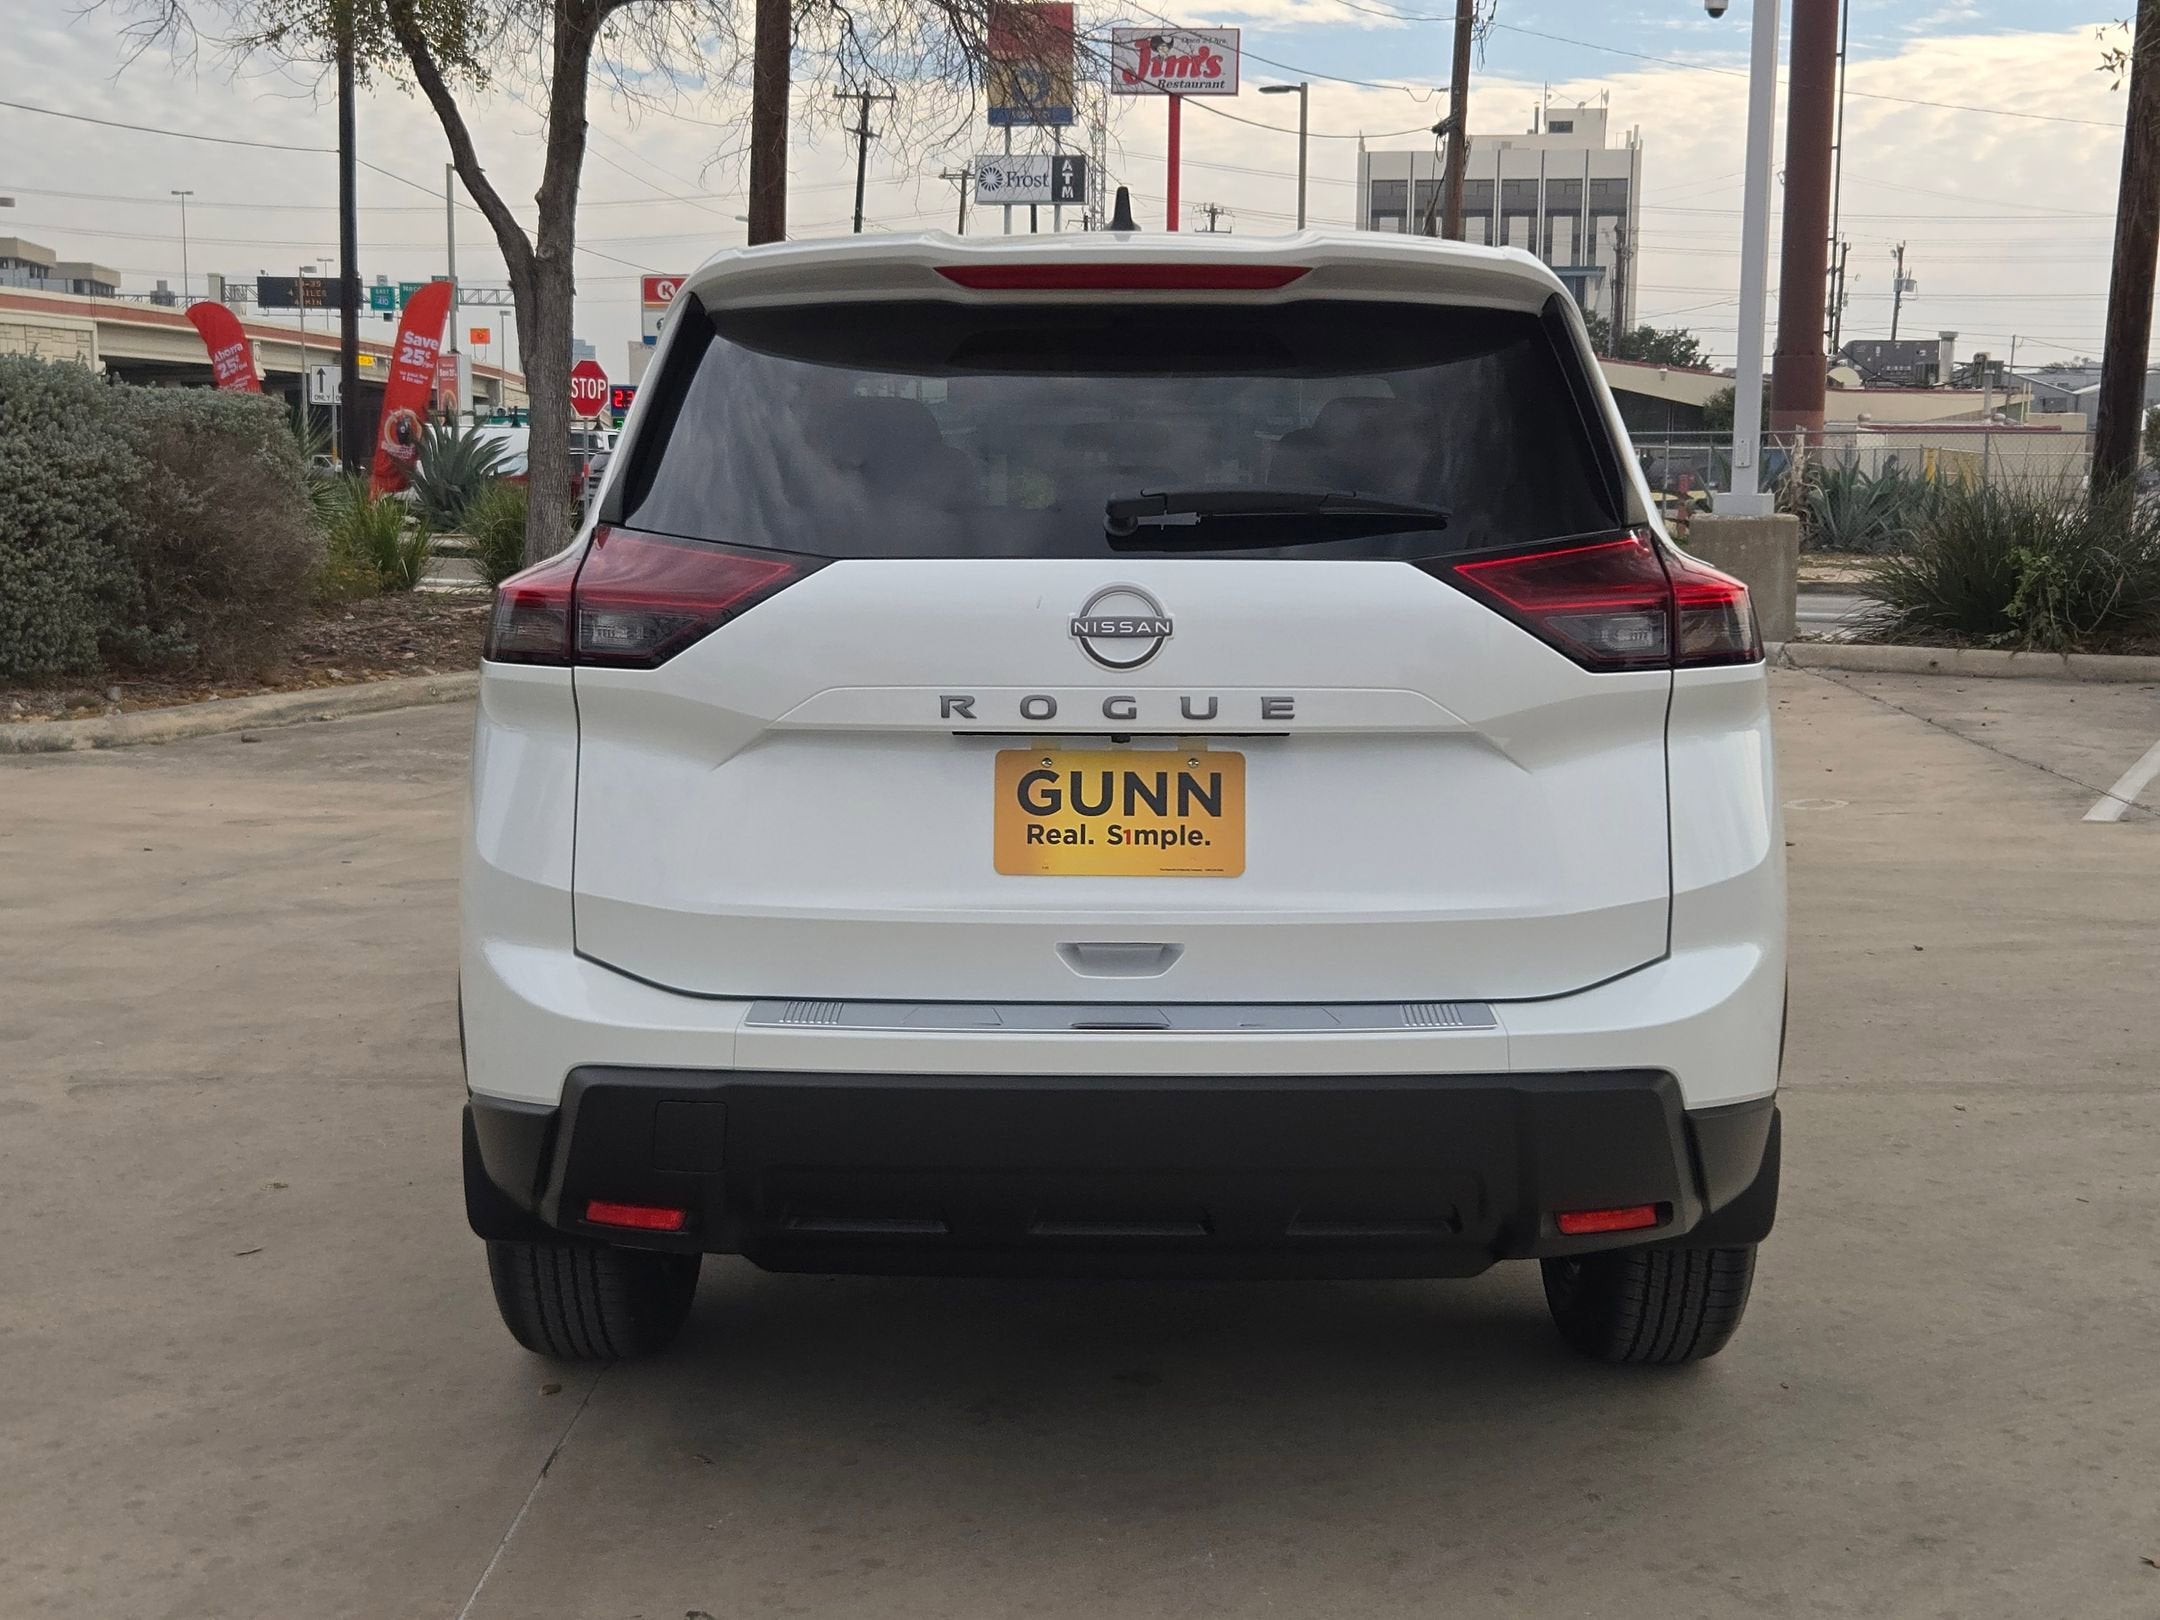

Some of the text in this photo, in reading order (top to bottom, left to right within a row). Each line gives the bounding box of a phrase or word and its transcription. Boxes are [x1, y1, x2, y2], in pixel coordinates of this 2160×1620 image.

[1122, 37, 1223, 85] Jim's
[1158, 79, 1225, 89] Restaurant
[1007, 171, 1049, 187] Frost
[1062, 160, 1074, 198] ATM
[403, 331, 439, 350] Save
[214, 343, 243, 361] Ahorra
[571, 378, 606, 399] STOP
[1074, 621, 1170, 633] NISSAN
[940, 694, 1295, 720] ROGUE
[1017, 769, 1222, 817] GUNN
[1027, 823, 1095, 845] Real.
